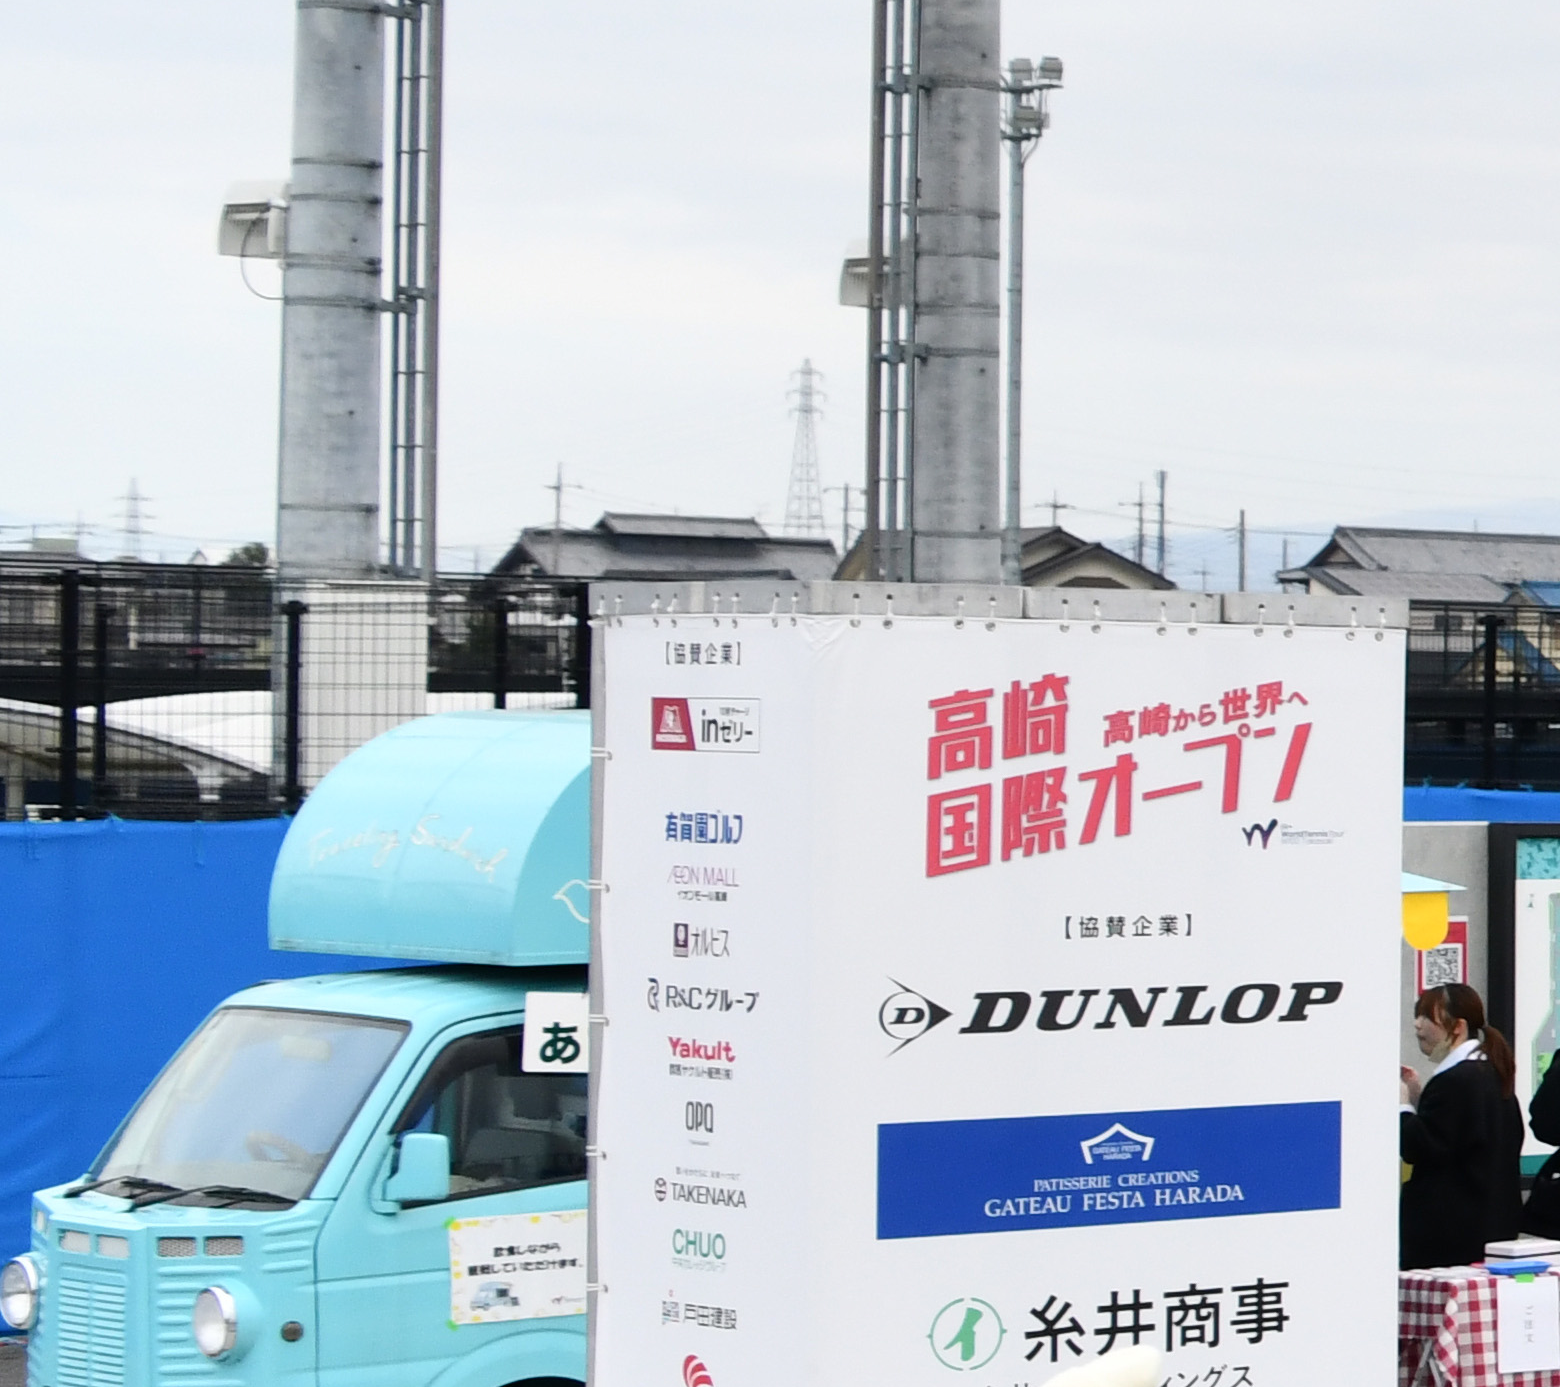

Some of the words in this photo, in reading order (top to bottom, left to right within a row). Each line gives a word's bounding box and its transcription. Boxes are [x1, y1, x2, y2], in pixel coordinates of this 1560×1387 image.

[928, 673, 1070, 781] 高崎
[1103, 681, 1309, 748] 高崎から世界へ
[926, 722, 1313, 878] 国際オープン
[665, 810, 743, 844] 有賀園ゴルフ
[1063, 913, 1194, 941] 【協賛企業】
[958, 981, 1344, 1035] DUNLOP
[539, 1022, 581, 1064] あ
[668, 1035, 736, 1063] Yakult
[671, 1182, 748, 1209] TAKENAKA
[1033, 1175, 1112, 1193] PATISSERIE
[1117, 1169, 1200, 1188] CREATIONS
[984, 1194, 1072, 1218] GATEAU
[1082, 1191, 1146, 1212] FESTA
[1154, 1184, 1245, 1207] HARADA
[672, 1228, 726, 1260] CHUO
[683, 1302, 738, 1331] 戸田建設
[1024, 1277, 1291, 1363] 糸井商事
